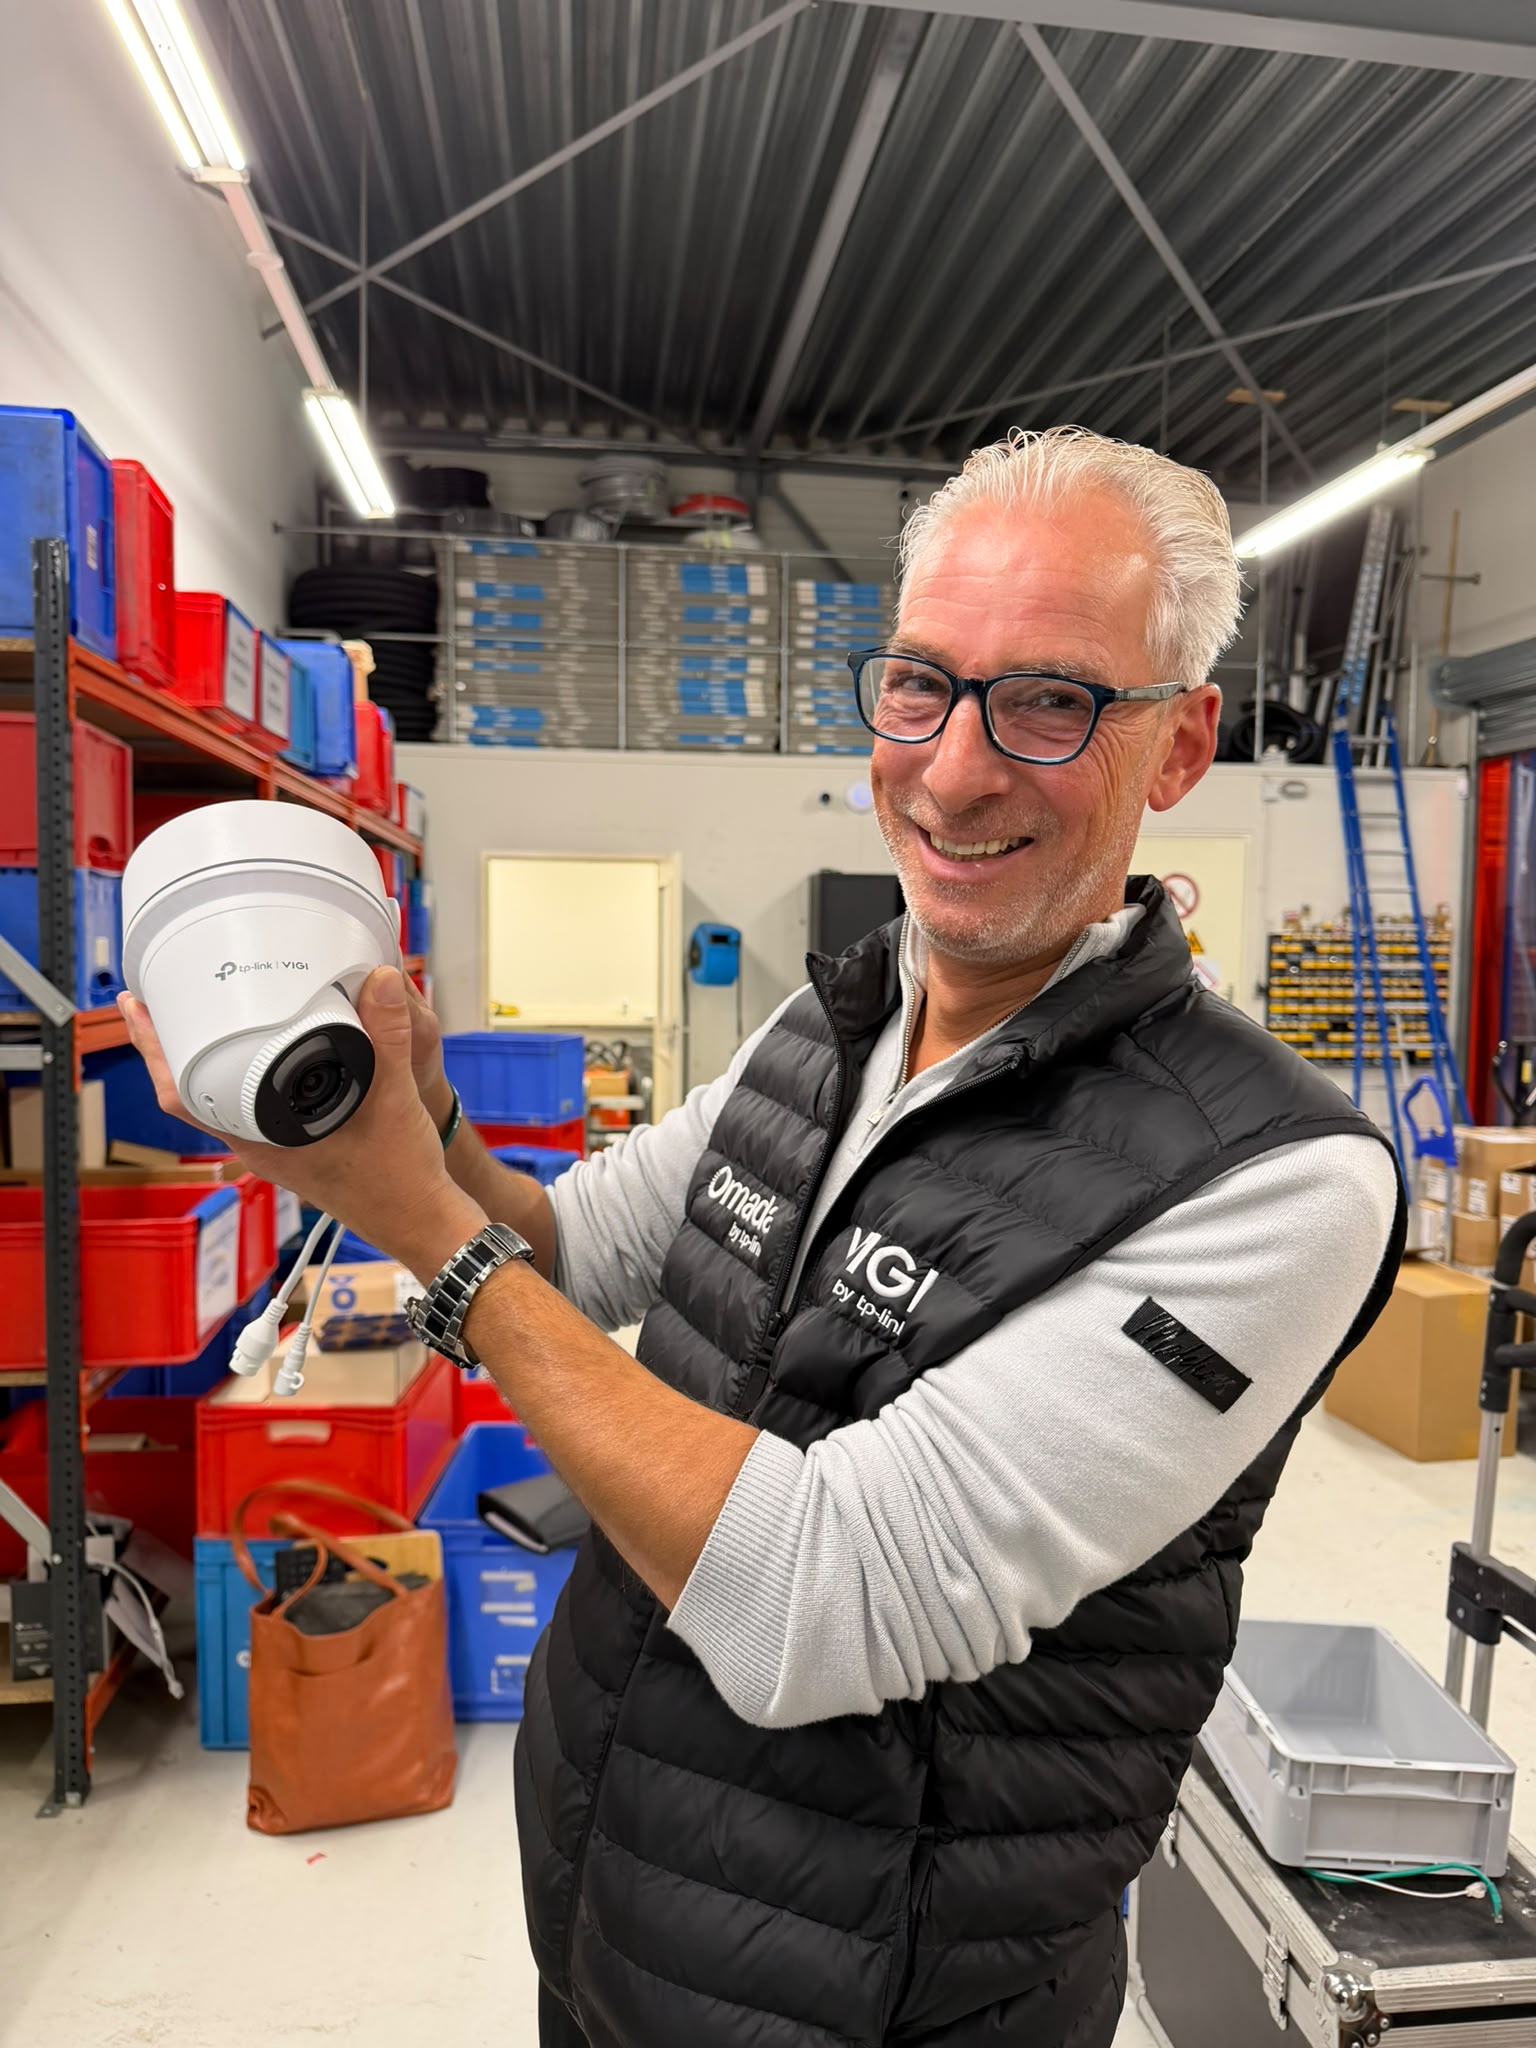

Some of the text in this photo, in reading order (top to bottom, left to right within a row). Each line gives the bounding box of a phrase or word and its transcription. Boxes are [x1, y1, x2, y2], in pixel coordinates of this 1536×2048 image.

[239, 961, 310, 974] tp-link VIGI
[728, 1220, 743, 1243] by
[845, 1226, 940, 1314] VIGI
[832, 1278, 856, 1303] by
